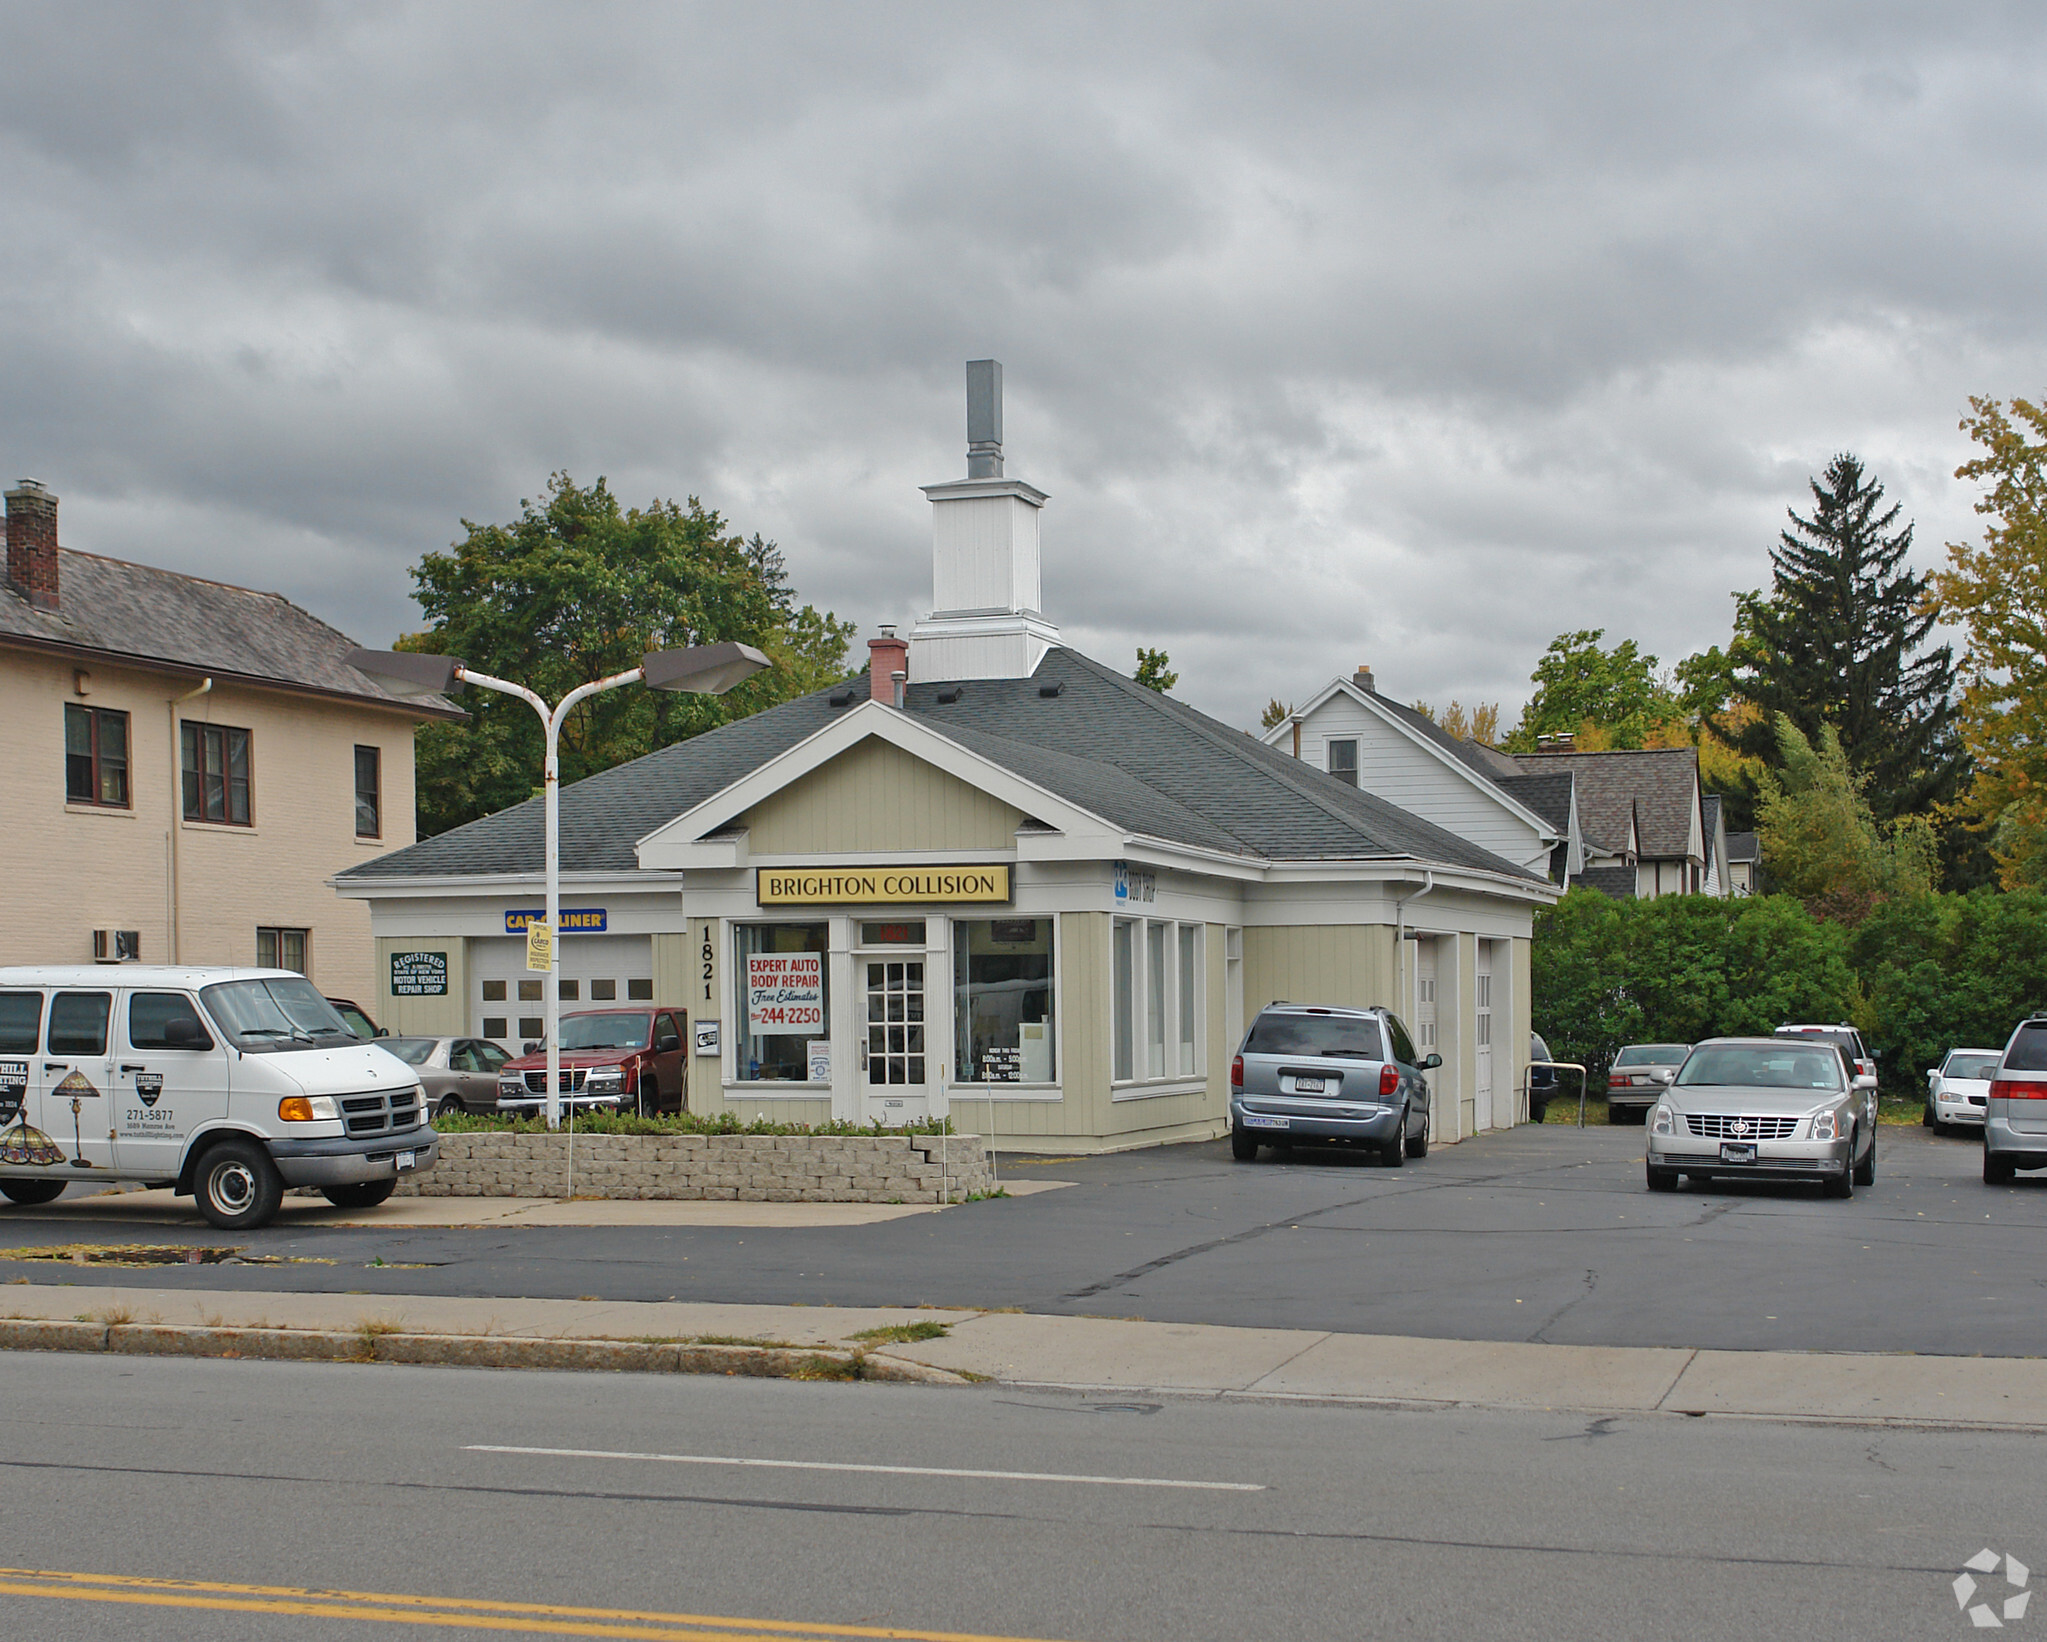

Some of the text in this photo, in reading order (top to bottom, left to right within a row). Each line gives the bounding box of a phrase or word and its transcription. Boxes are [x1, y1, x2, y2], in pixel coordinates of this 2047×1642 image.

[770, 875, 995, 896] BRIGHTON COLLISION
[880, 924, 908, 941] 1821
[393, 953, 445, 969] REGISTERED
[702, 924, 713, 1000] 1821
[750, 959, 819, 972] EXPERT AUTO
[393, 975, 446, 984] MOTOR VEHICLE
[751, 975, 819, 988] BODY REPAIR
[397, 985, 442, 994] REPAIR SHOP
[751, 989, 819, 1005] Free Estimates
[126, 1109, 173, 1121] 271-5877
